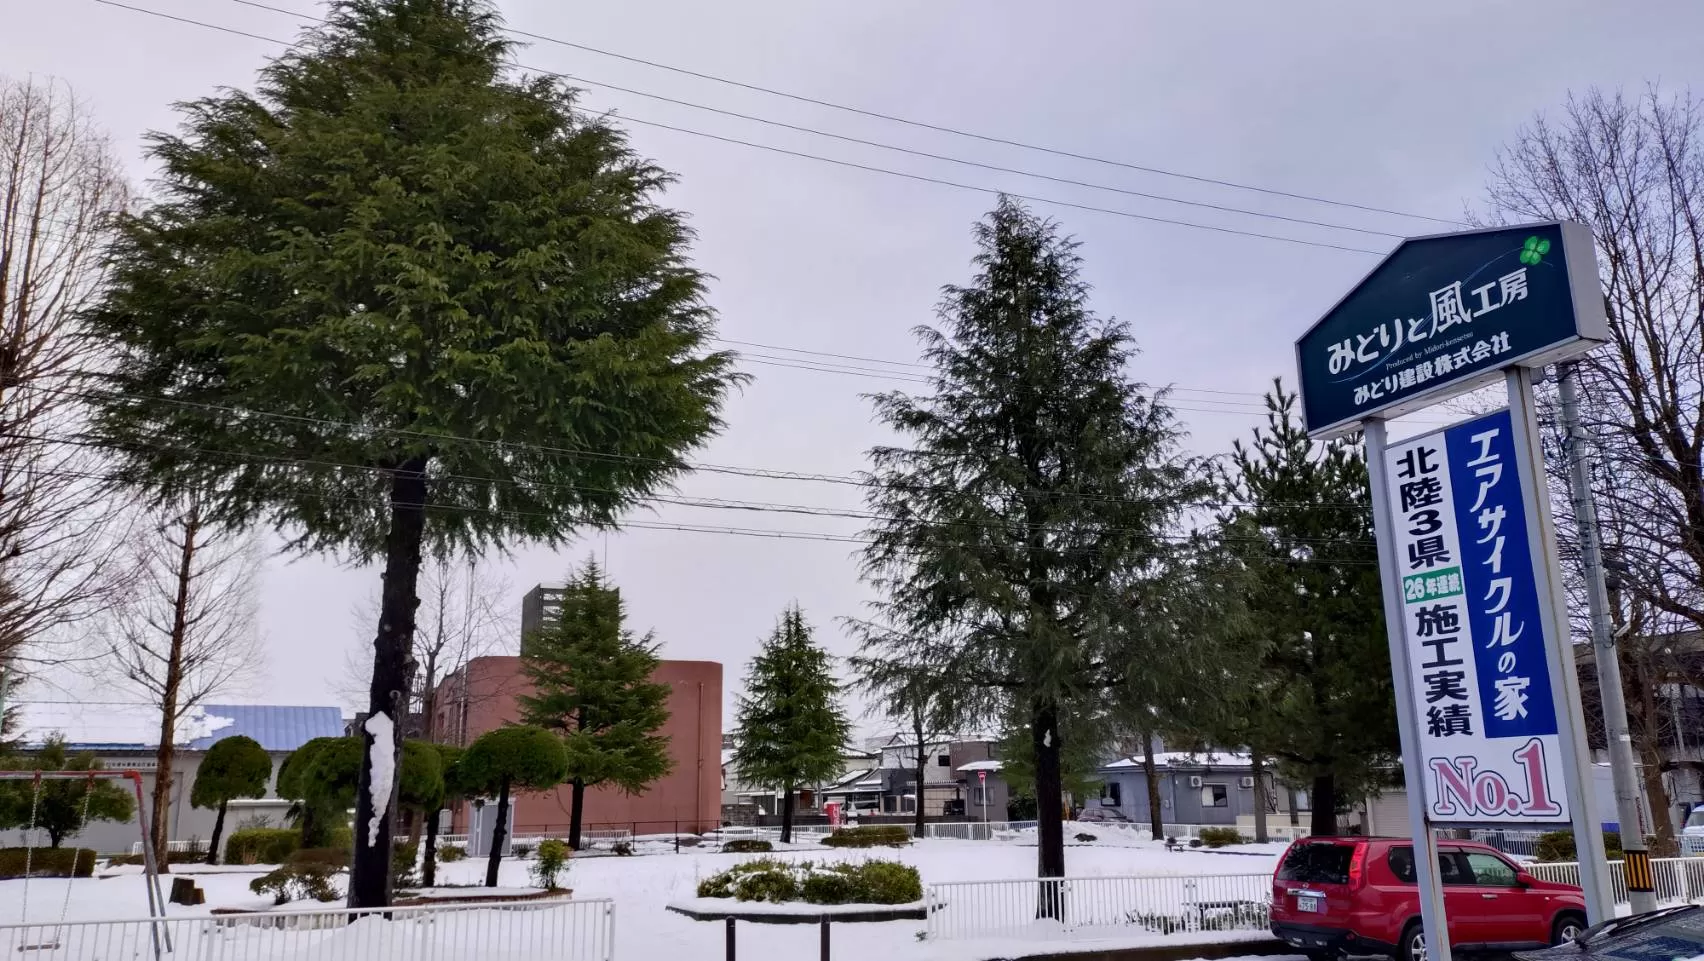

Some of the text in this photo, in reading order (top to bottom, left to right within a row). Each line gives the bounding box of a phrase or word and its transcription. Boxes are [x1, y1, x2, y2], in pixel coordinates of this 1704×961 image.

[1327, 267, 1529, 375] みどりと風工房
[1353, 331, 1512, 406] みどり建設株式会社
[1385, 331, 1474, 371] Produced by Midori-kensetsu
[1396, 446, 1451, 569] 北陸3県
[1467, 428, 1530, 720] エアサイクルの家
[1415, 604, 1473, 738] 施工実績
[1429, 737, 1562, 816] No.1
